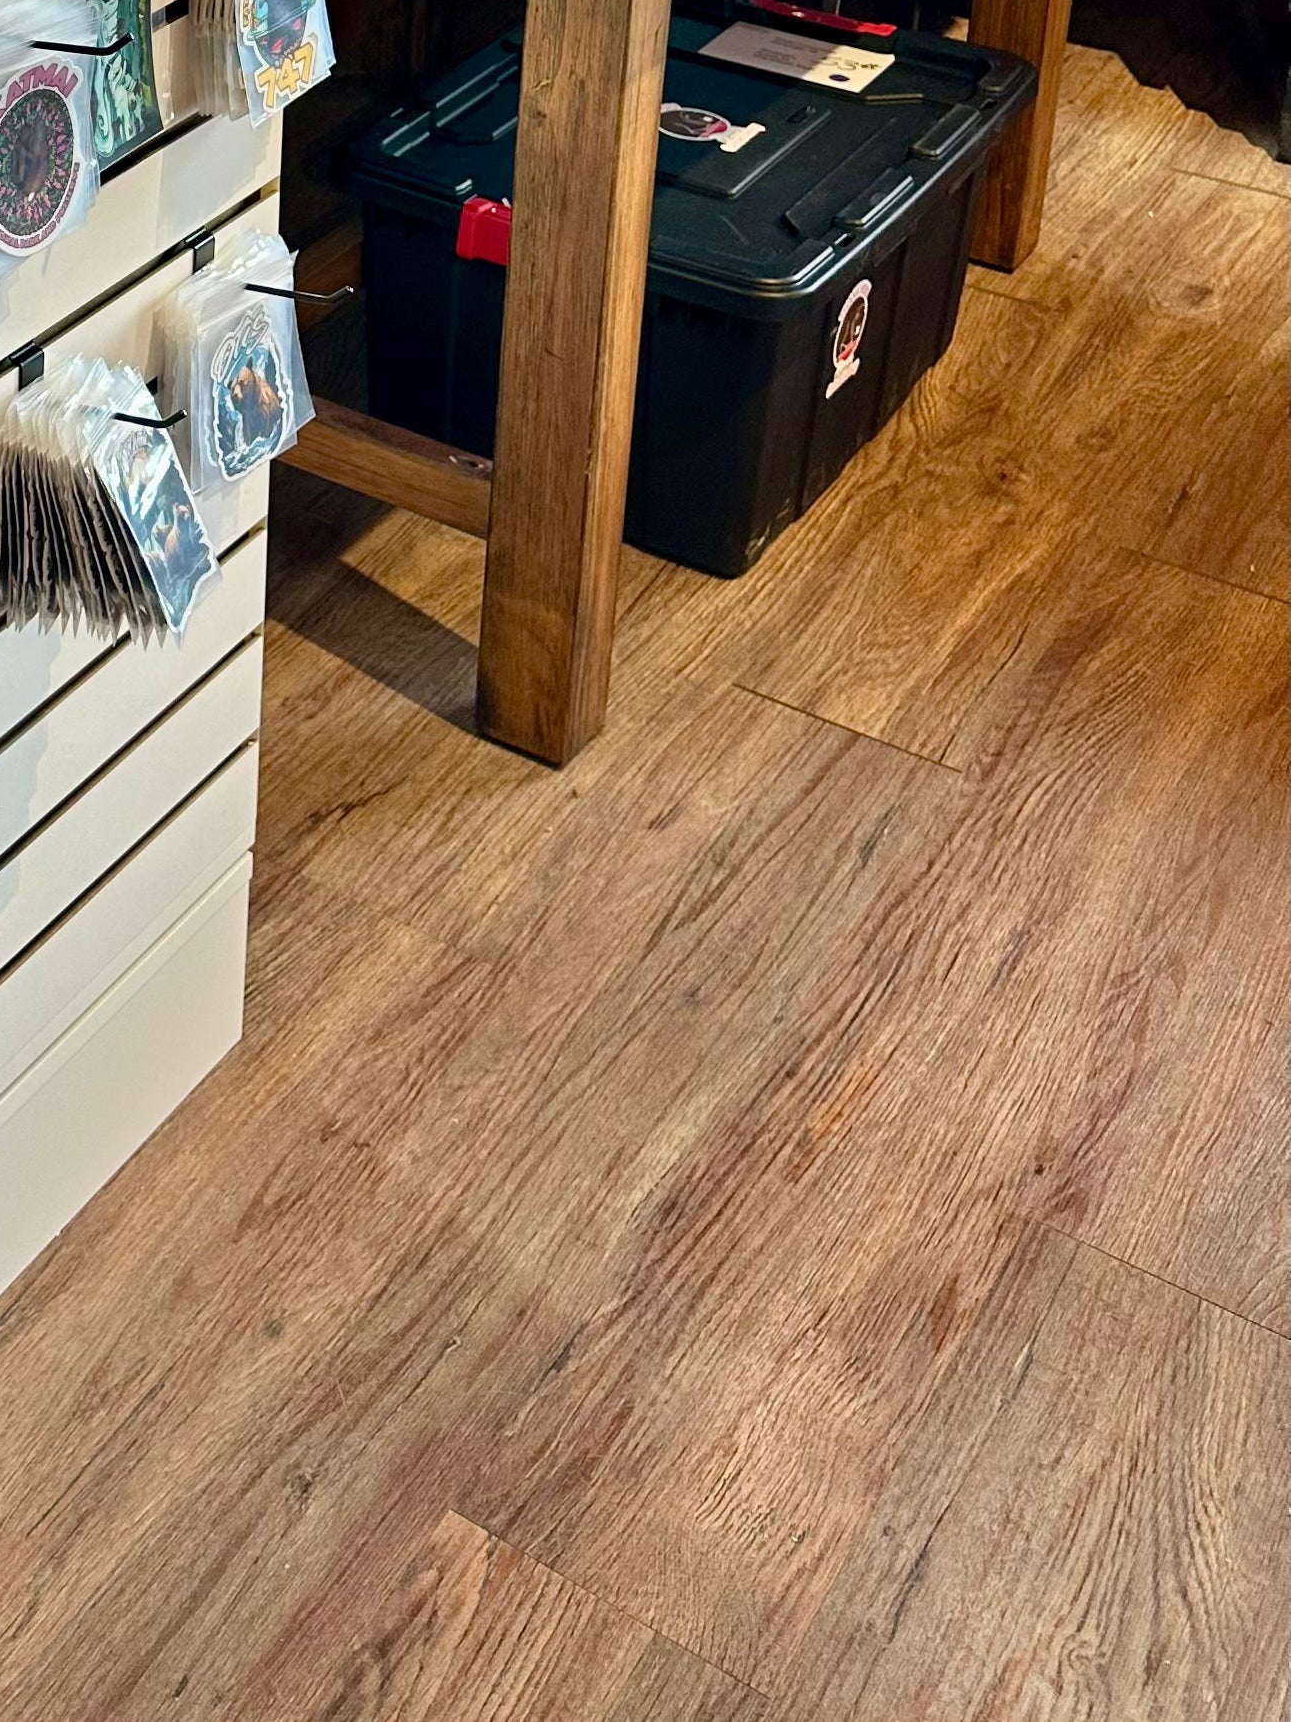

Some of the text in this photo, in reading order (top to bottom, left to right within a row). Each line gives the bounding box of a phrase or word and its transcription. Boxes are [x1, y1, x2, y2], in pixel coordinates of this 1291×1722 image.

[258, 42, 314, 108] 747
[20, 235, 39, 249] PARK
[39, 220, 57, 242] AND
